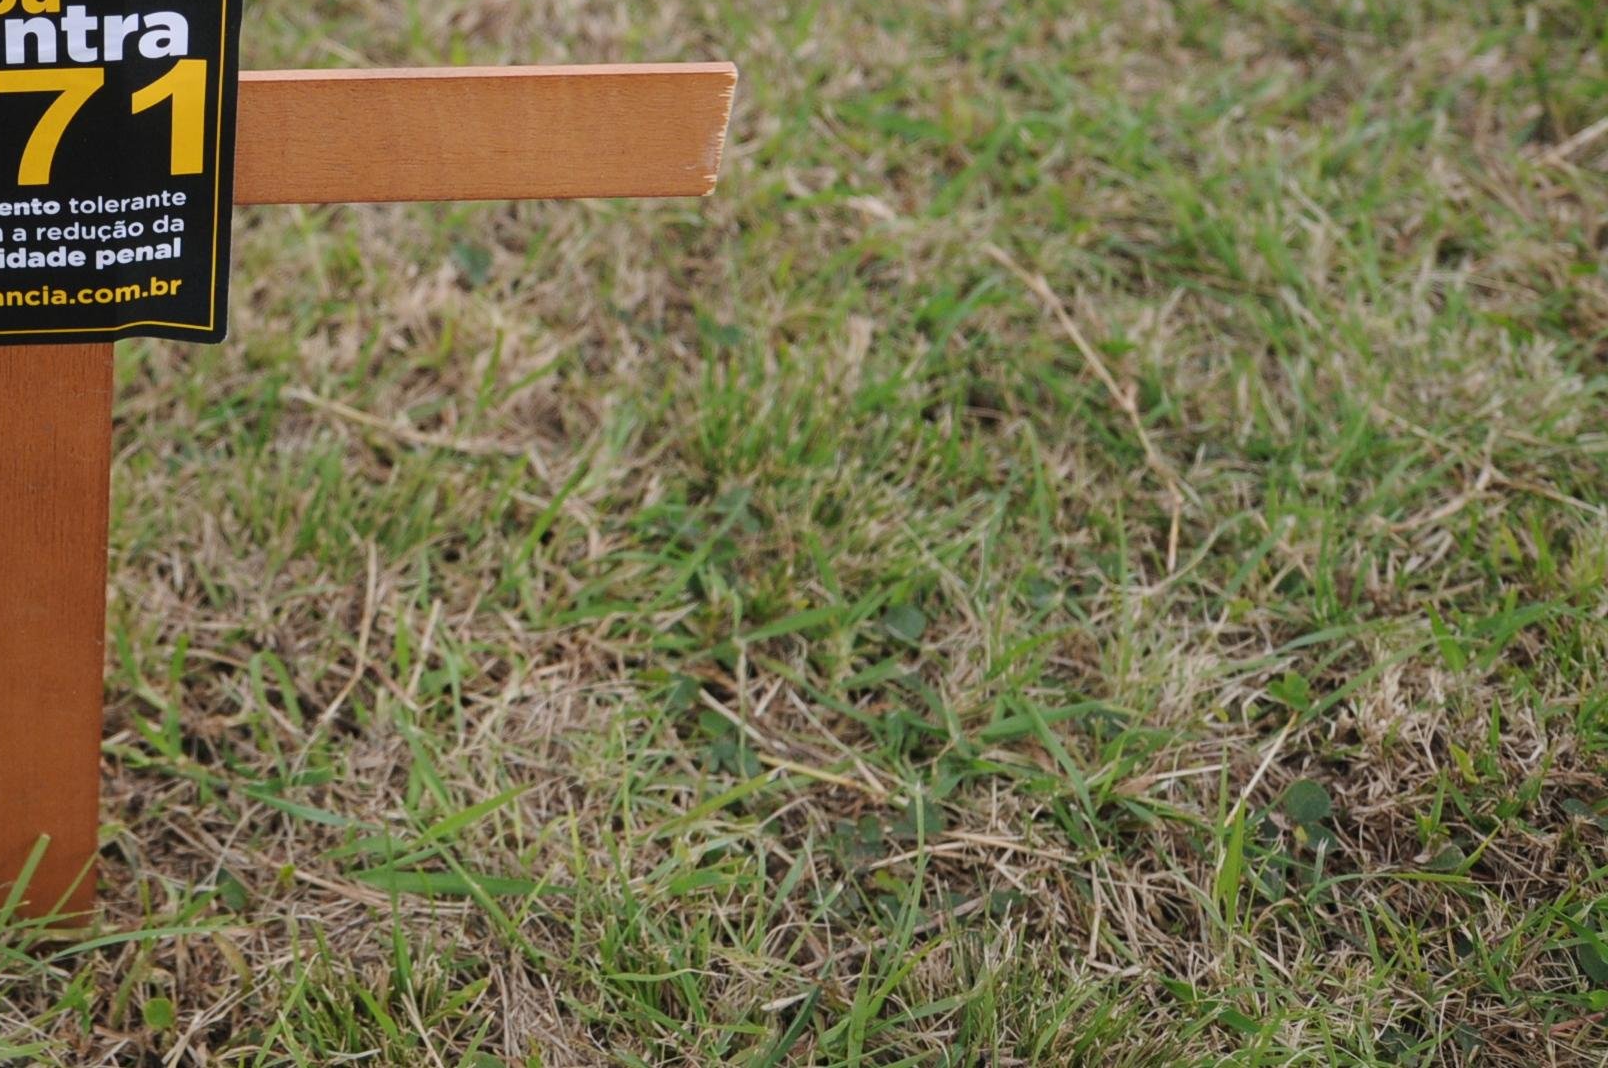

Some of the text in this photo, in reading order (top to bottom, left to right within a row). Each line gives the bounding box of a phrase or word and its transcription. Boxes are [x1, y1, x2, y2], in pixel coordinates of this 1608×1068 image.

[69, 190, 187, 214] tolerante
[12, 228, 27, 241] a
[36, 220, 144, 242] redução
[152, 215, 185, 234] da
[96, 237, 181, 269] penal
